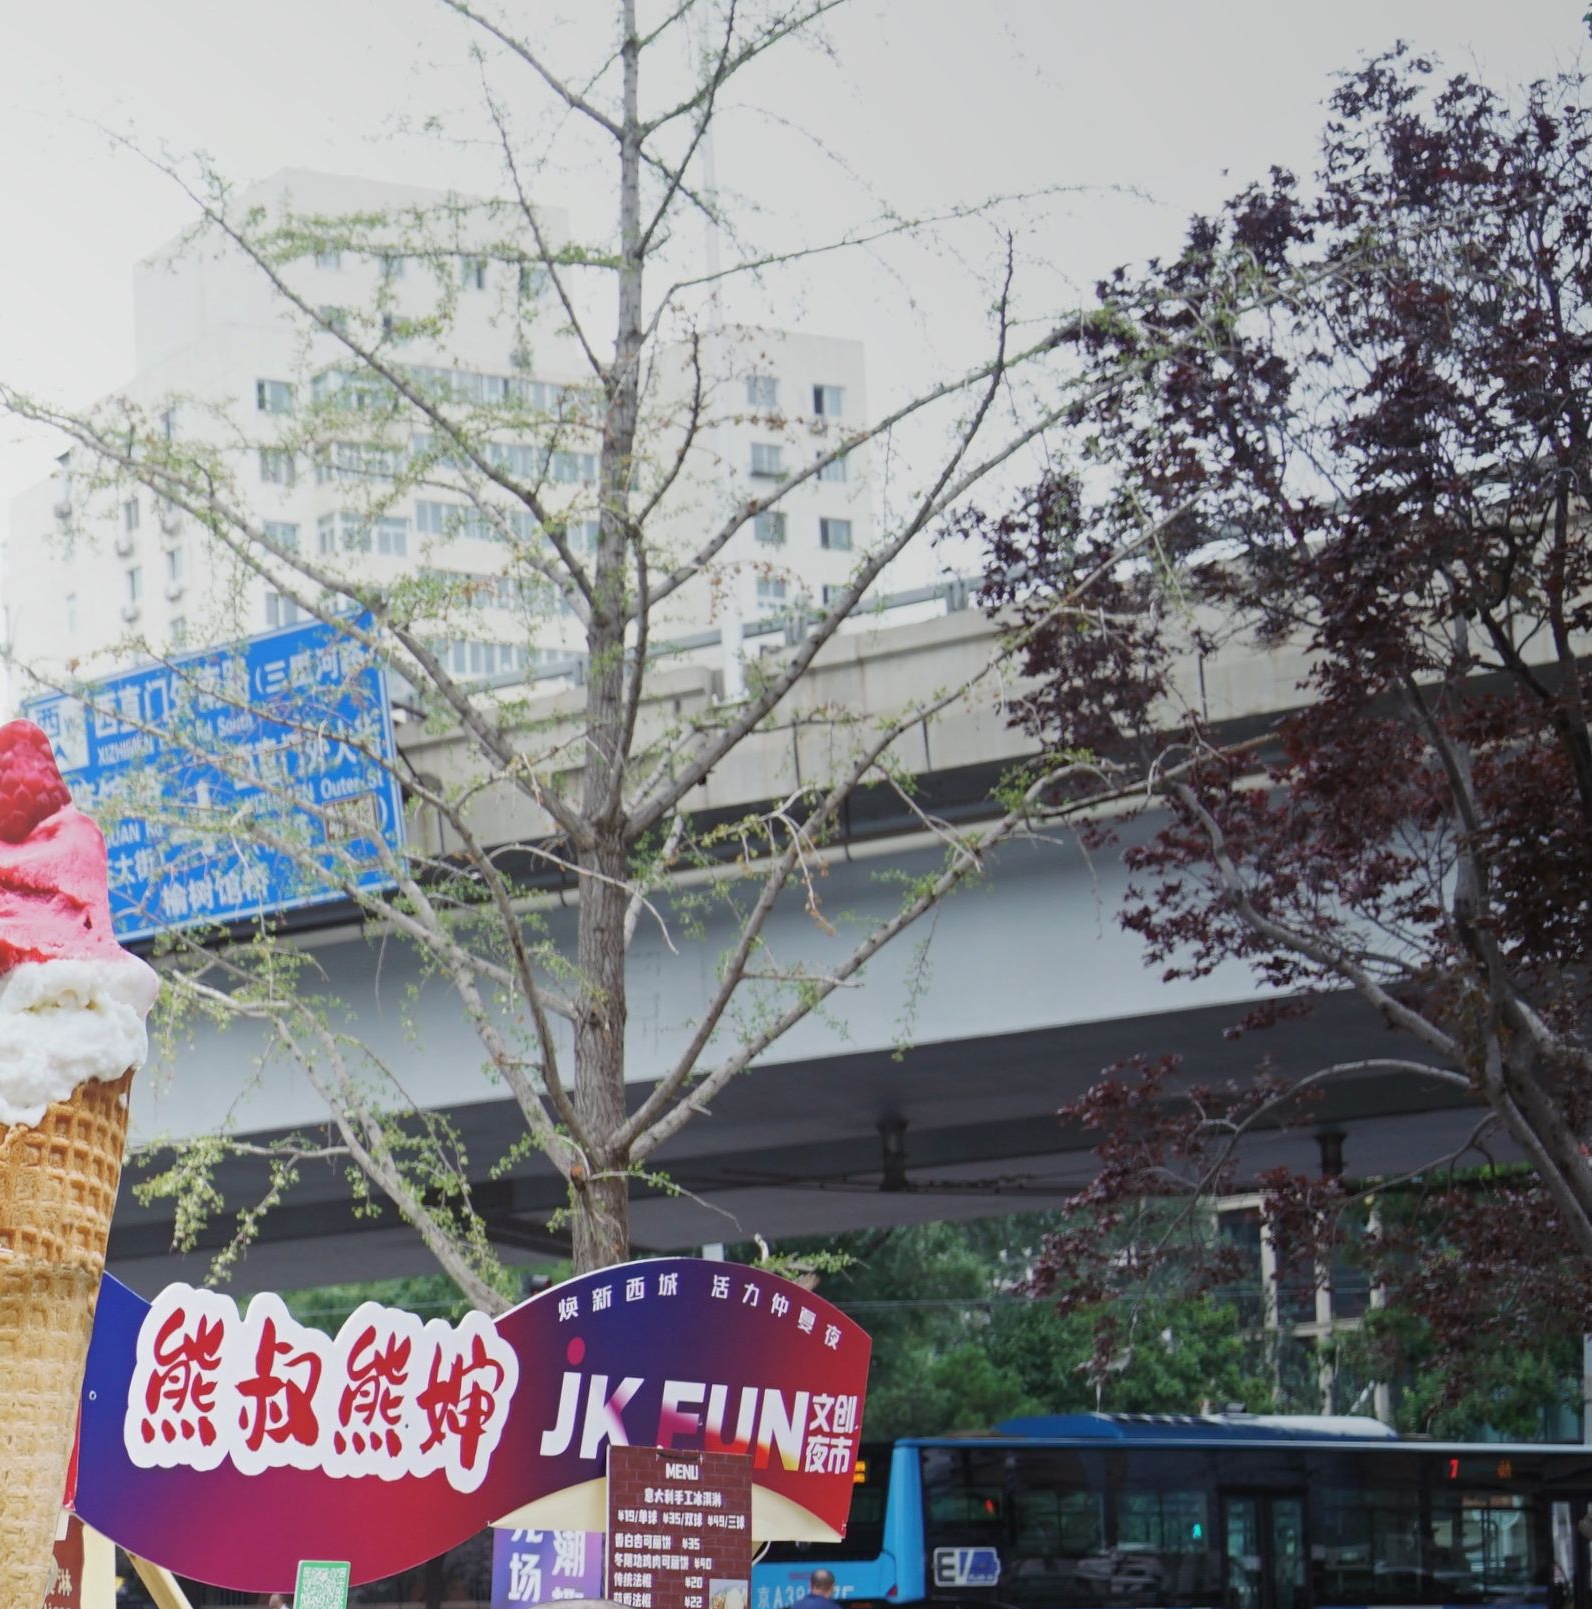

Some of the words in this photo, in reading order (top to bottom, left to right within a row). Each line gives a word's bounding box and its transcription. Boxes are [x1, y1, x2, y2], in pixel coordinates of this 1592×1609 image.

[558, 1272, 679, 1323] 焕新西城
[710, 1274, 844, 1350] 活力仲夏夜
[656, 1378, 810, 1472] FUN
[809, 1392, 858, 1434] 文创
[665, 1462, 699, 1481] MENU
[804, 1435, 853, 1475] 夜市
